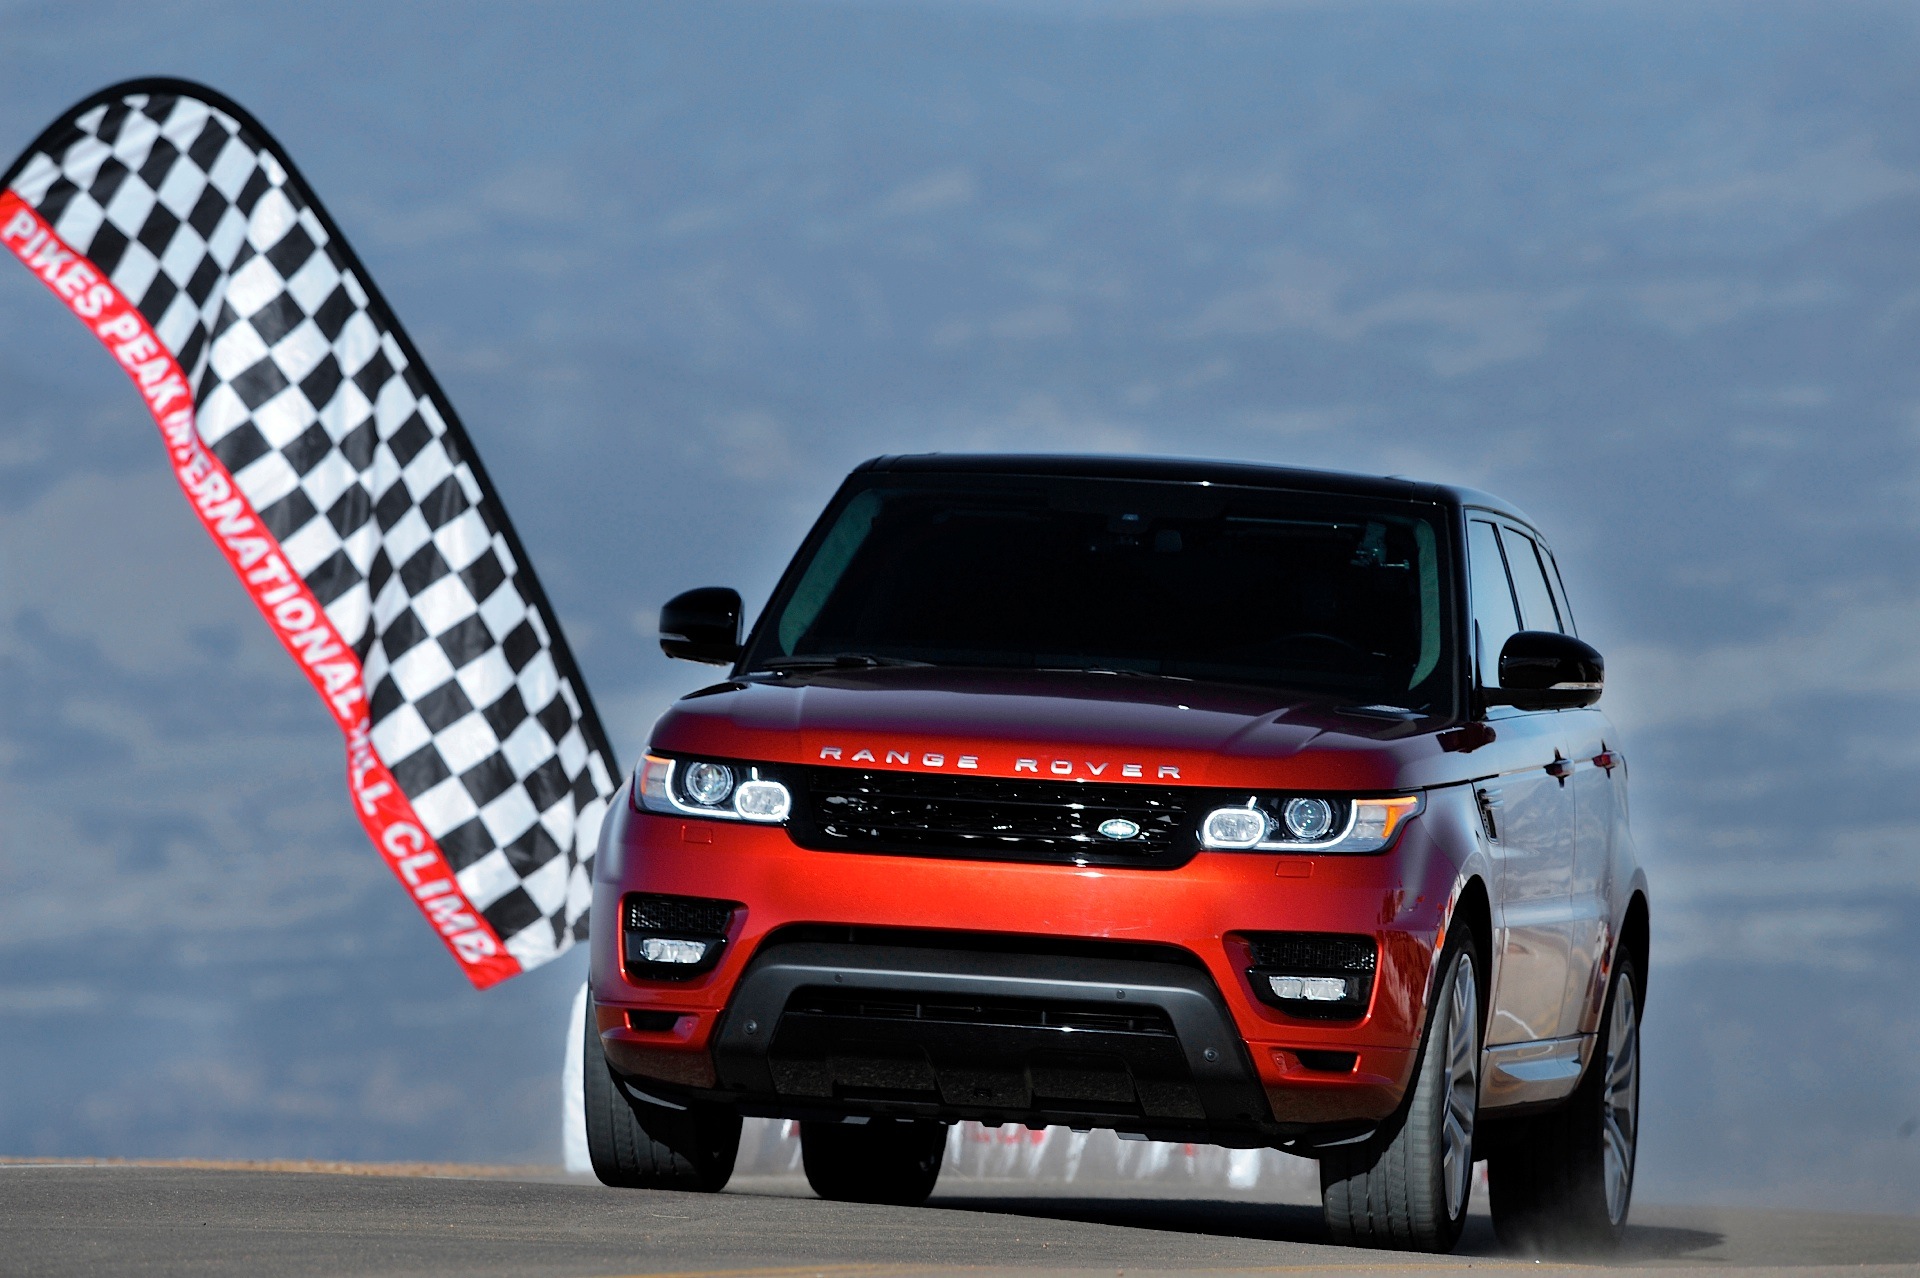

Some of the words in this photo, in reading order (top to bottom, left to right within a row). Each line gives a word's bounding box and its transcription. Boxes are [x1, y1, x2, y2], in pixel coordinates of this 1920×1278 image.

[3, 210, 115, 318] PIKES
[97, 311, 187, 411] PEAK
[381, 821, 497, 965] CLIMB
[819, 746, 979, 770] RANGE
[1014, 757, 1181, 780] ROVER
